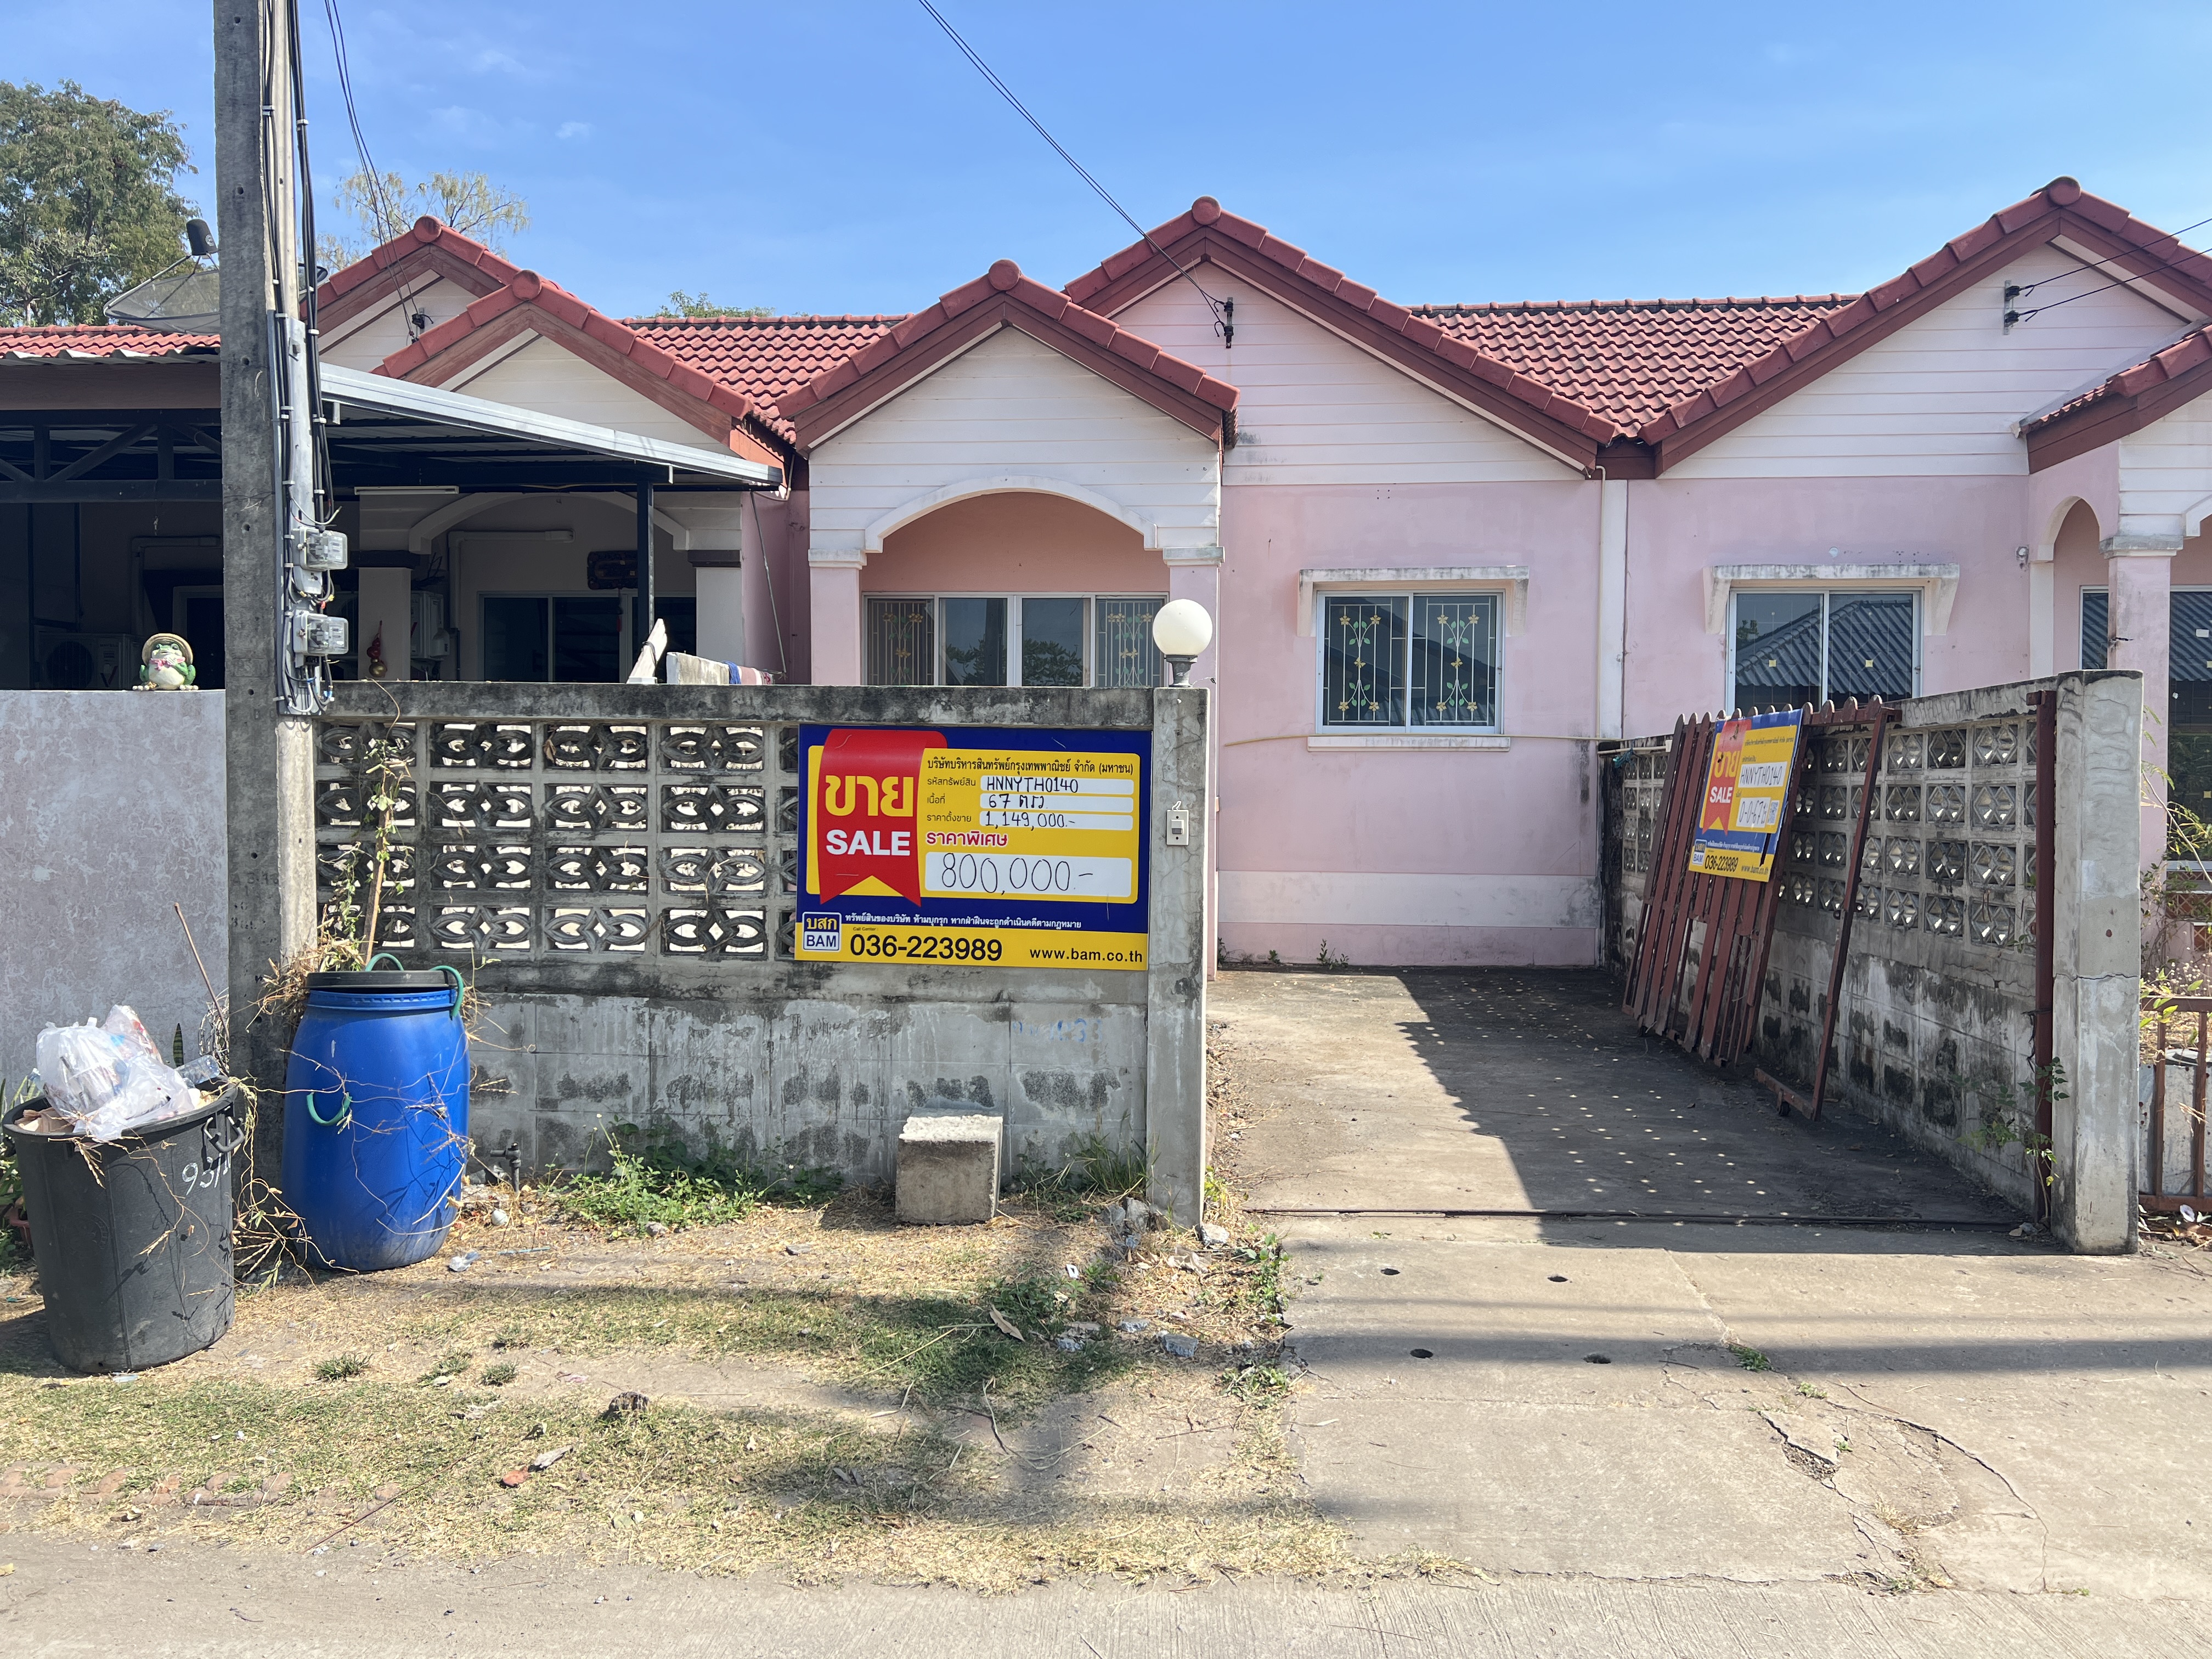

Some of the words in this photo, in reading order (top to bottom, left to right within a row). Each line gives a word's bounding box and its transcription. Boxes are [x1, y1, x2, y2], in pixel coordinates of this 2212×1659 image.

[928, 757, 1070, 775] บริษัทบริหารสินทรัพย์กรุงเทพพาณิชย์
[1074, 759, 1096, 772] จำกัด
[1099, 761, 1133, 775] (มหาชน)
[927, 776, 976, 786] รหัสทรัพย์สิน
[987, 776, 1079, 793] HNNYTH0140
[825, 775, 914, 817] ขาย
[927, 793, 945, 804] เนื้อที่
[989, 793, 1011, 809] 67
[1709, 786, 1733, 803] SALE
[927, 813, 972, 823] ราคาตั้งขาย
[826, 829, 911, 856] SALE
[926, 830, 1008, 847] ราคาพิเศษ
[806, 916, 838, 930] บสก
[845, 912, 911, 924] ทรัพย์สินของบริษัท
[913, 914, 949, 927] ห้ามบุกรุก
[806, 935, 837, 947] BAM
[850, 933, 1002, 961] 036-223989
[1030, 948, 1143, 962] www.bam.co.th
